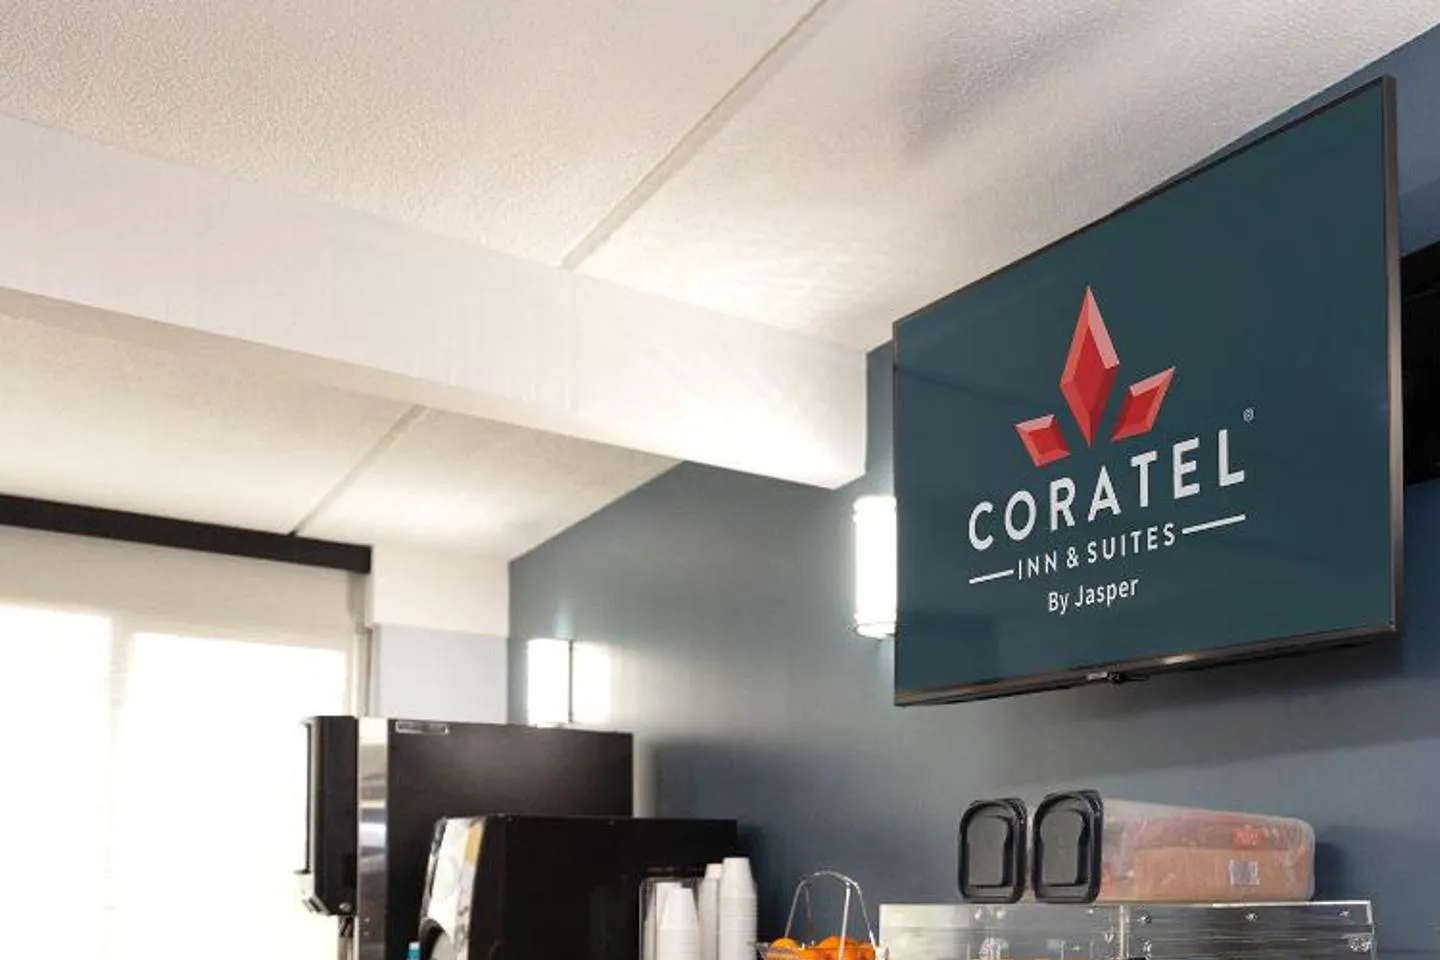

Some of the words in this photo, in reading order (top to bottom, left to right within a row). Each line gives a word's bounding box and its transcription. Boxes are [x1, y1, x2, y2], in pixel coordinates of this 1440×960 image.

[968, 429, 1245, 551] CORATEL
[1017, 550, 1058, 580] INN
[1066, 546, 1079, 568] &
[1087, 522, 1176, 564] SUITES
[1048, 591, 1069, 615] By
[1074, 577, 1139, 608] Jasper
